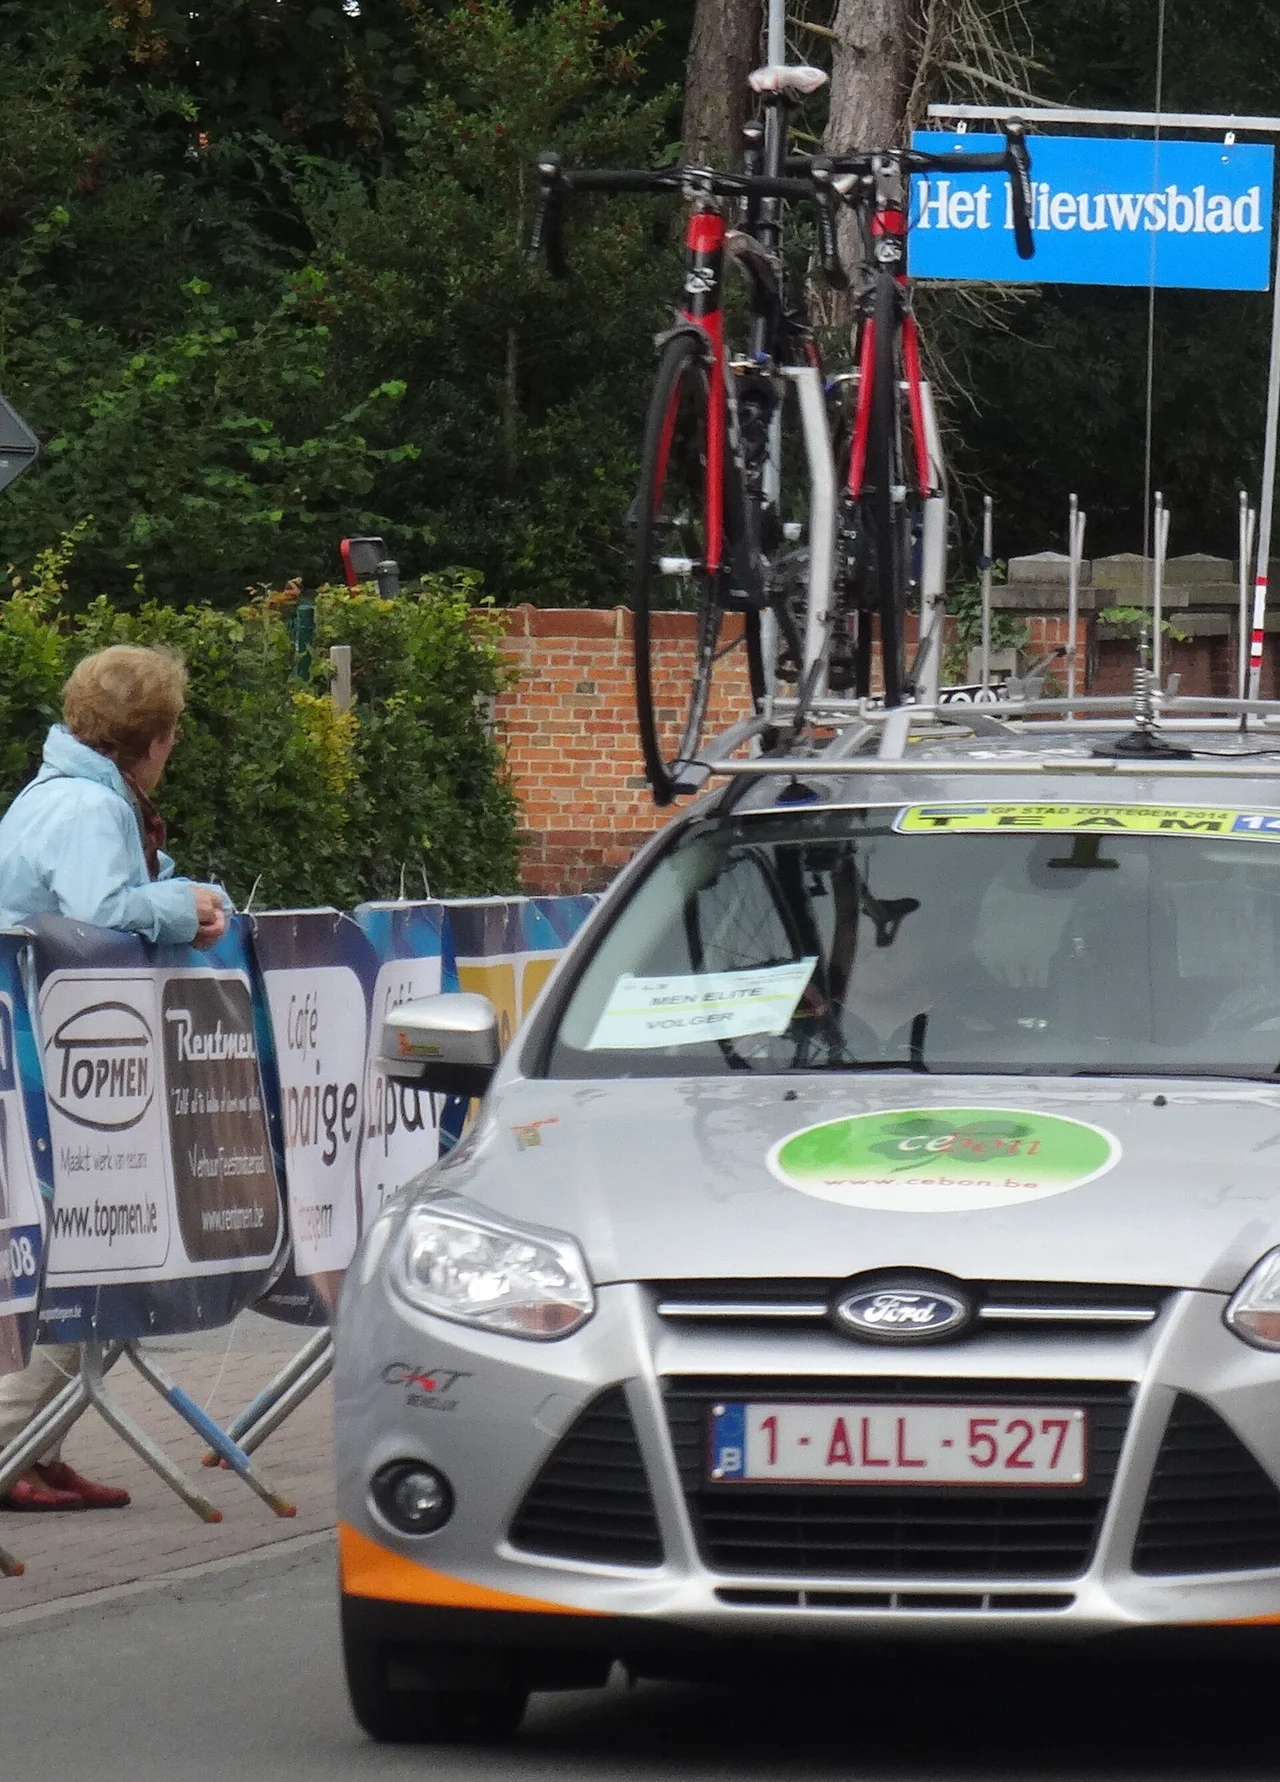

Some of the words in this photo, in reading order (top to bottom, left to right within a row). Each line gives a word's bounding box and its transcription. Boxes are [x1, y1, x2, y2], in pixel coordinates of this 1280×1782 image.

[917, 181, 992, 229] Het
[1003, 181, 1264, 234] Nieuwsblad
[991, 807, 1016, 815] GP
[1022, 807, 1071, 815] STAD
[1075, 807, 1182, 818] ZOTTEGEM
[1184, 811, 1230, 820] 2014
[917, 815, 1224, 832] TEAM
[651, 994, 698, 1006] MEN
[703, 987, 764, 1002] ELITE
[287, 991, 318, 1062] Café
[646, 1012, 735, 1030] VOLGER
[823, 1176, 1039, 1189] www.cebon.be
[863, 1293, 937, 1324] Ford
[719, 1446, 743, 1473] B
